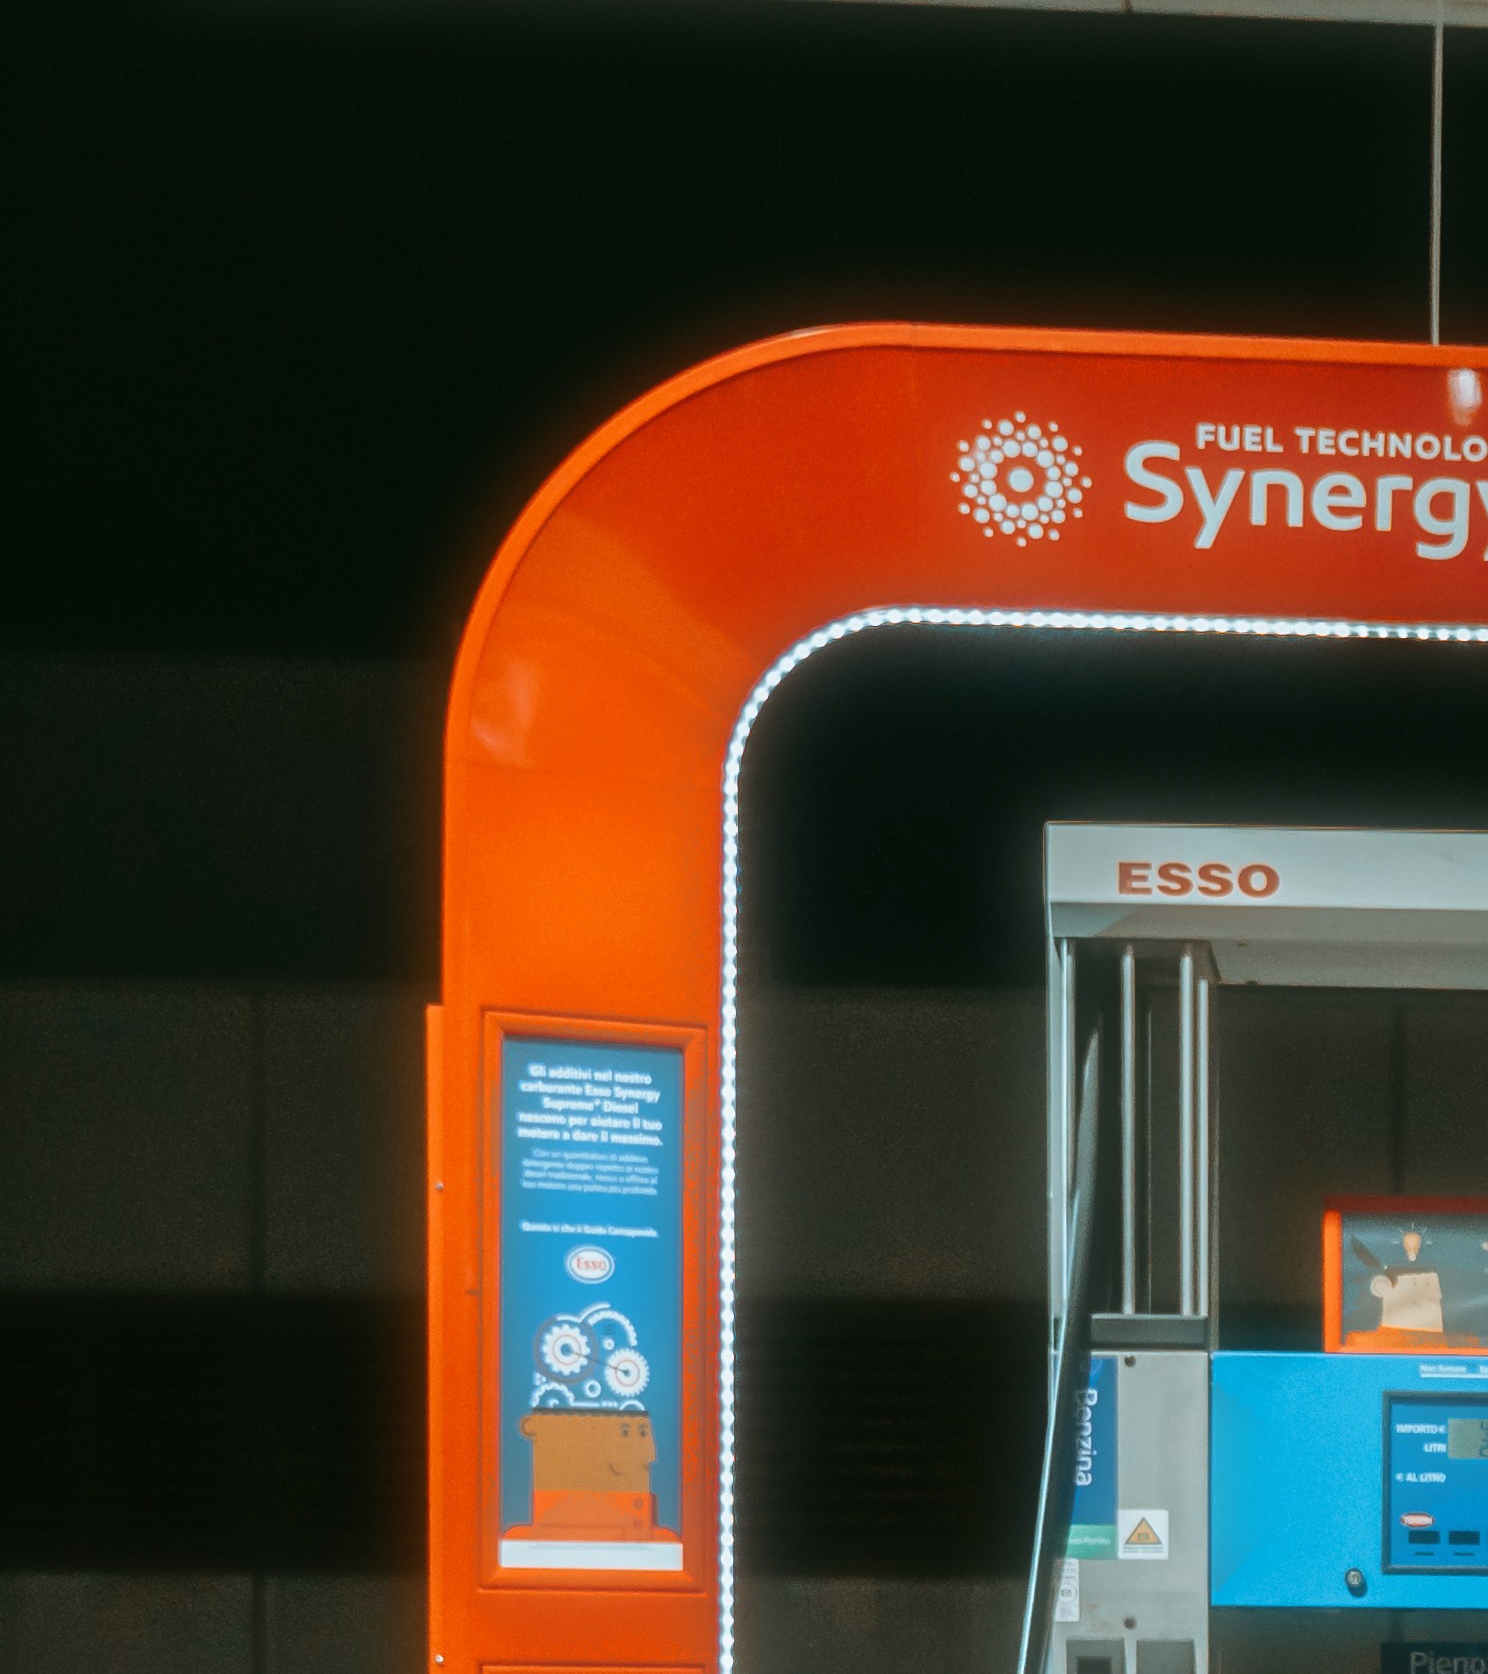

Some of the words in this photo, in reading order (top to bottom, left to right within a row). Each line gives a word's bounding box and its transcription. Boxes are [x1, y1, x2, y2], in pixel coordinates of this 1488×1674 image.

[1195, 423, 1283, 453] FUEL
[1117, 861, 1281, 898] ESSO
[577, 1257, 607, 1272] Esso
